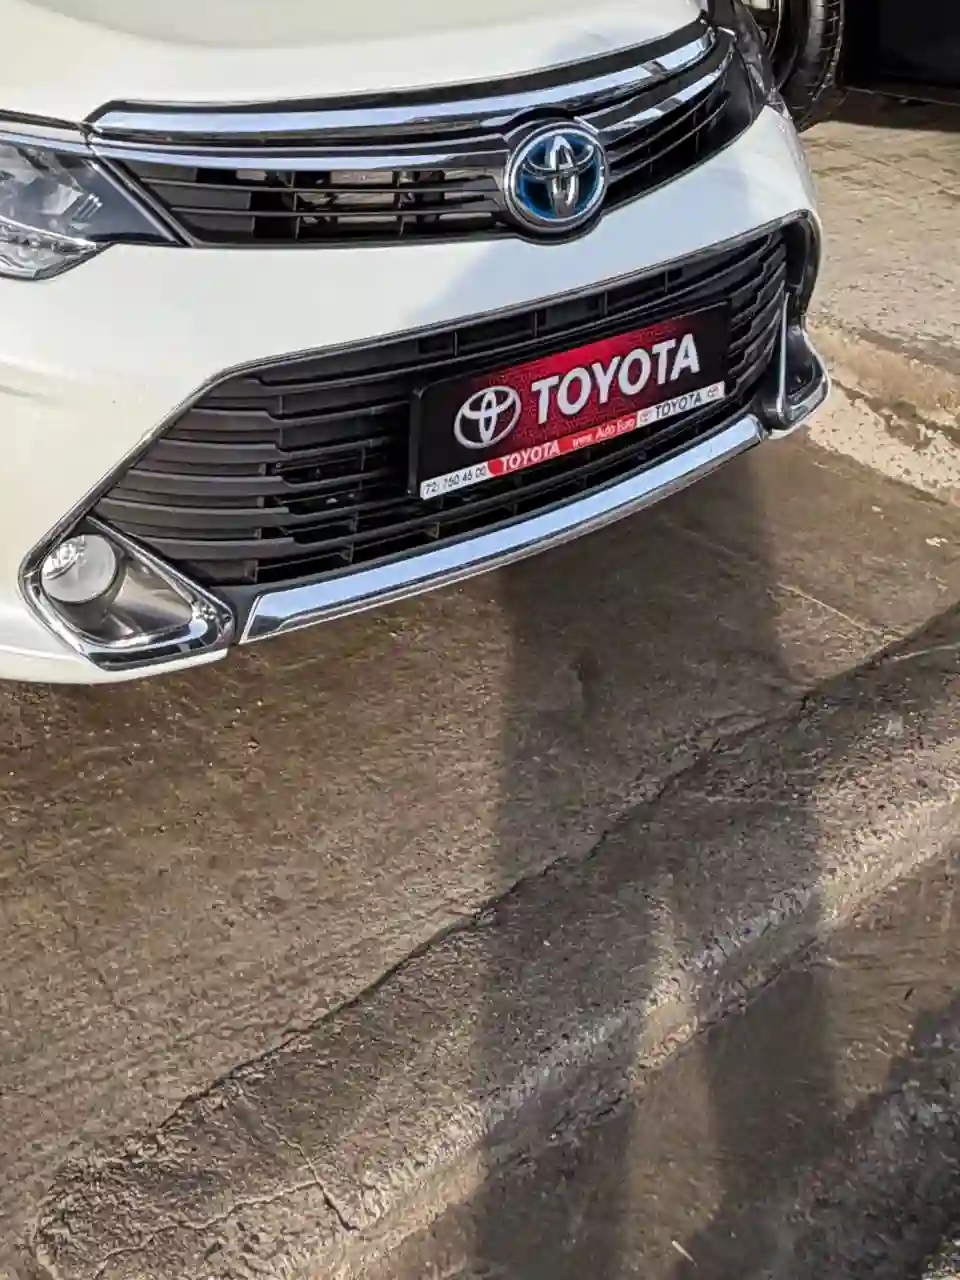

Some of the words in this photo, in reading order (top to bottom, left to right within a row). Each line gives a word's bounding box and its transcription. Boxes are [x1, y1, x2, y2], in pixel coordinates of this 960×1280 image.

[531, 333, 701, 424] TOYOTA
[655, 393, 703, 418] TOYOTA
[501, 439, 561, 472] TOYOTA
